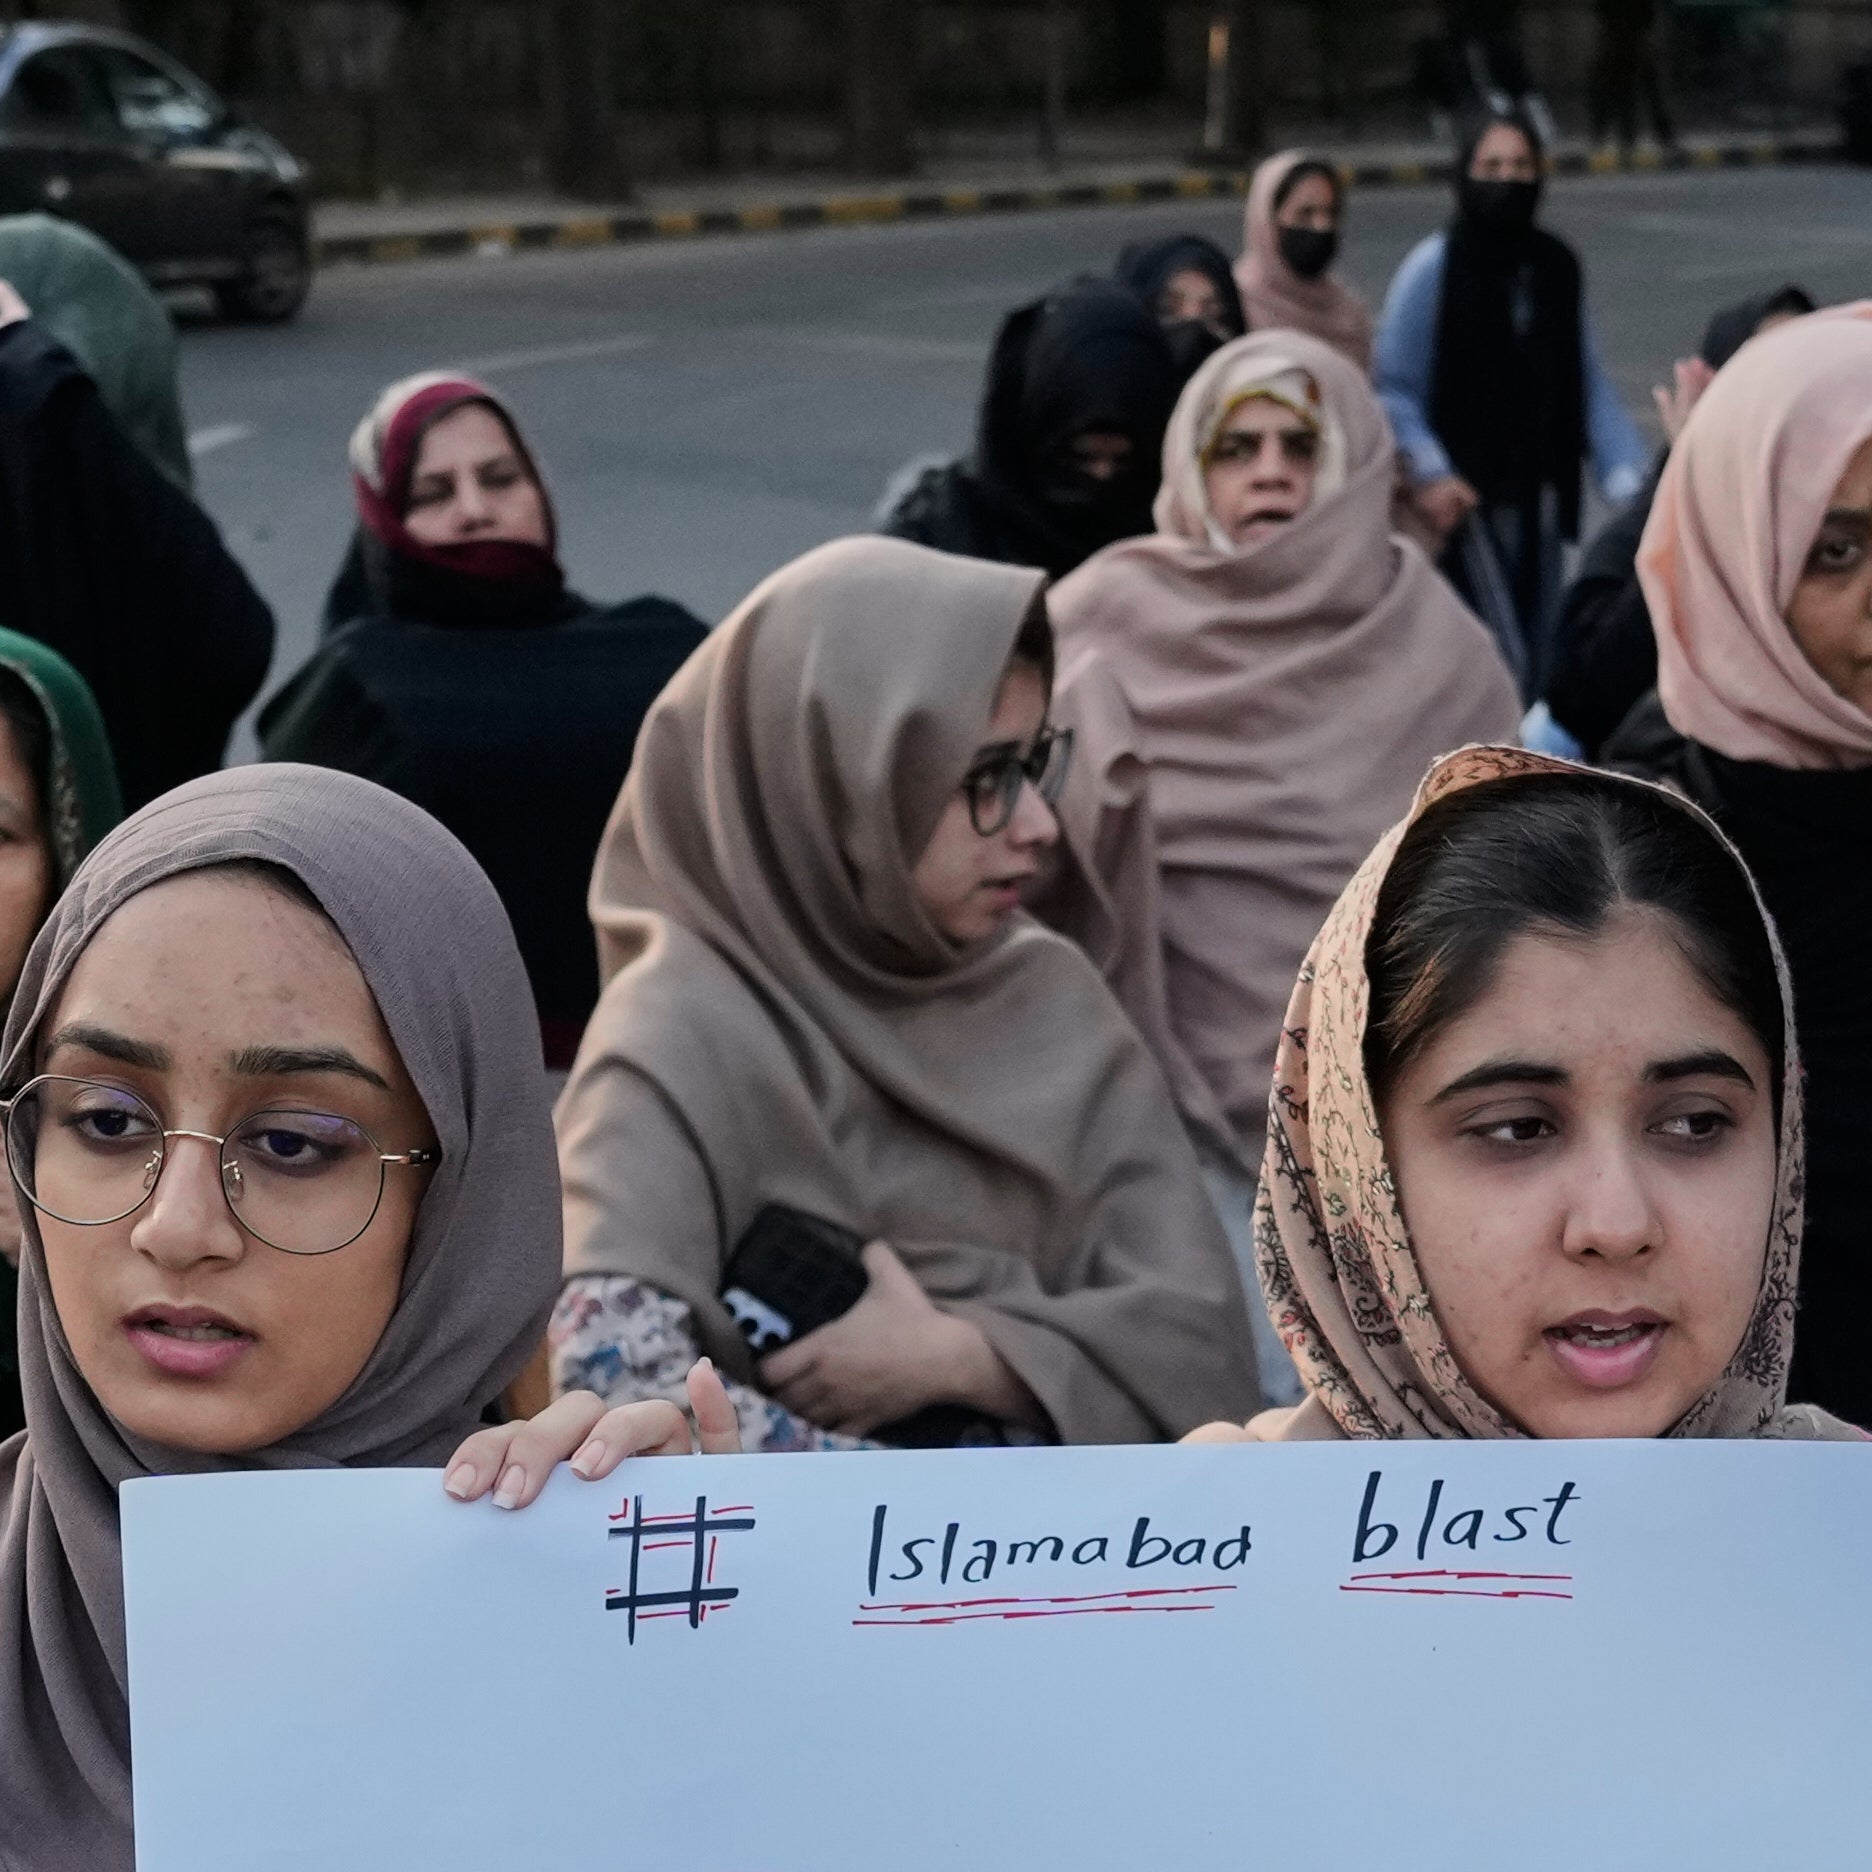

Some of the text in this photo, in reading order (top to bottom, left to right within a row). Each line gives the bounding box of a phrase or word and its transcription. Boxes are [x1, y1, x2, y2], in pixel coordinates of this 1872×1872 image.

[606, 1470, 1581, 1645] # Islamabad blast
